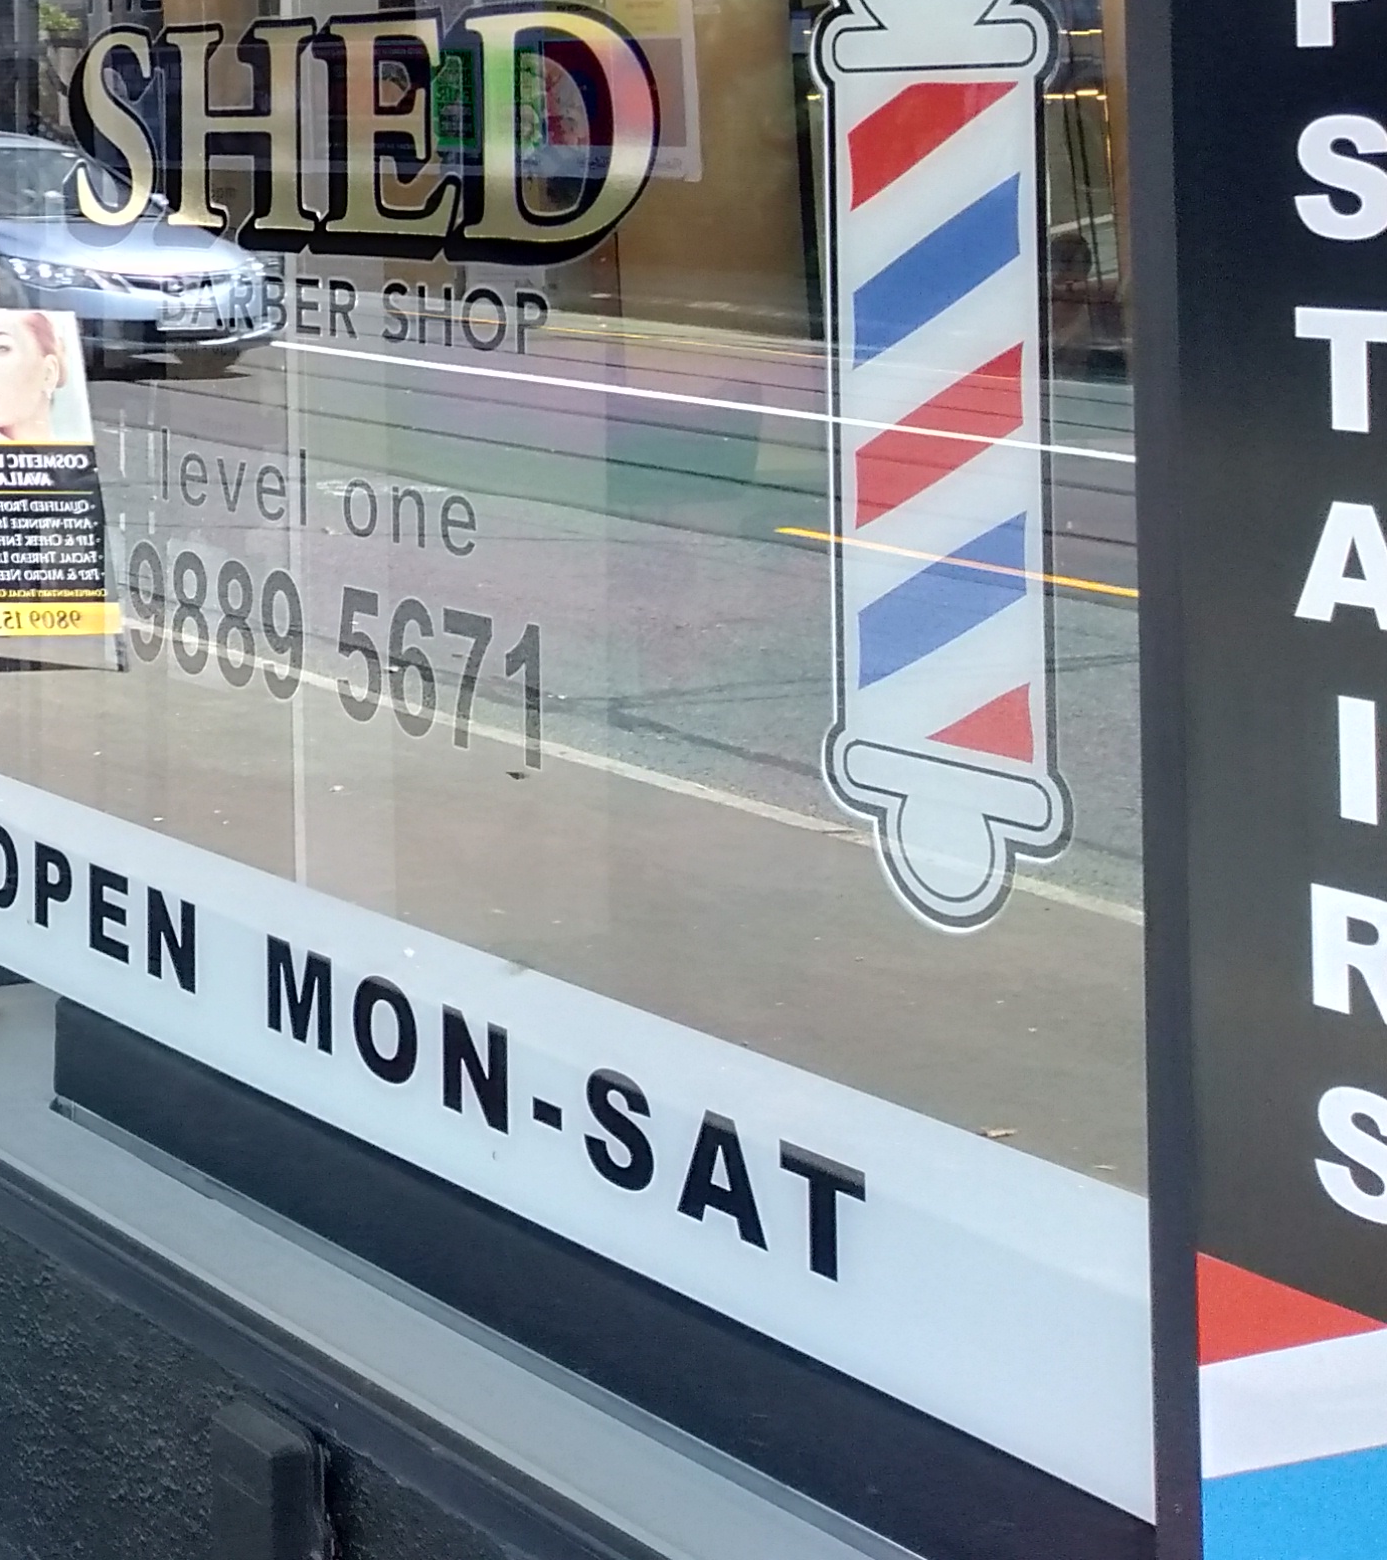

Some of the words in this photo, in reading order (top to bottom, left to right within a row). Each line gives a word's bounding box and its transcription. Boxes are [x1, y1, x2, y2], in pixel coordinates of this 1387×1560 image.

[69, 2, 660, 266] SHED
[161, 274, 358, 341] BARBER
[381, 282, 549, 356] SHOP
[160, 427, 308, 527] level
[342, 477, 478, 557] one
[128, 539, 304, 702] 9889
[335, 584, 543, 771] 5671
[265, 934, 867, 1283] MON-SAT
